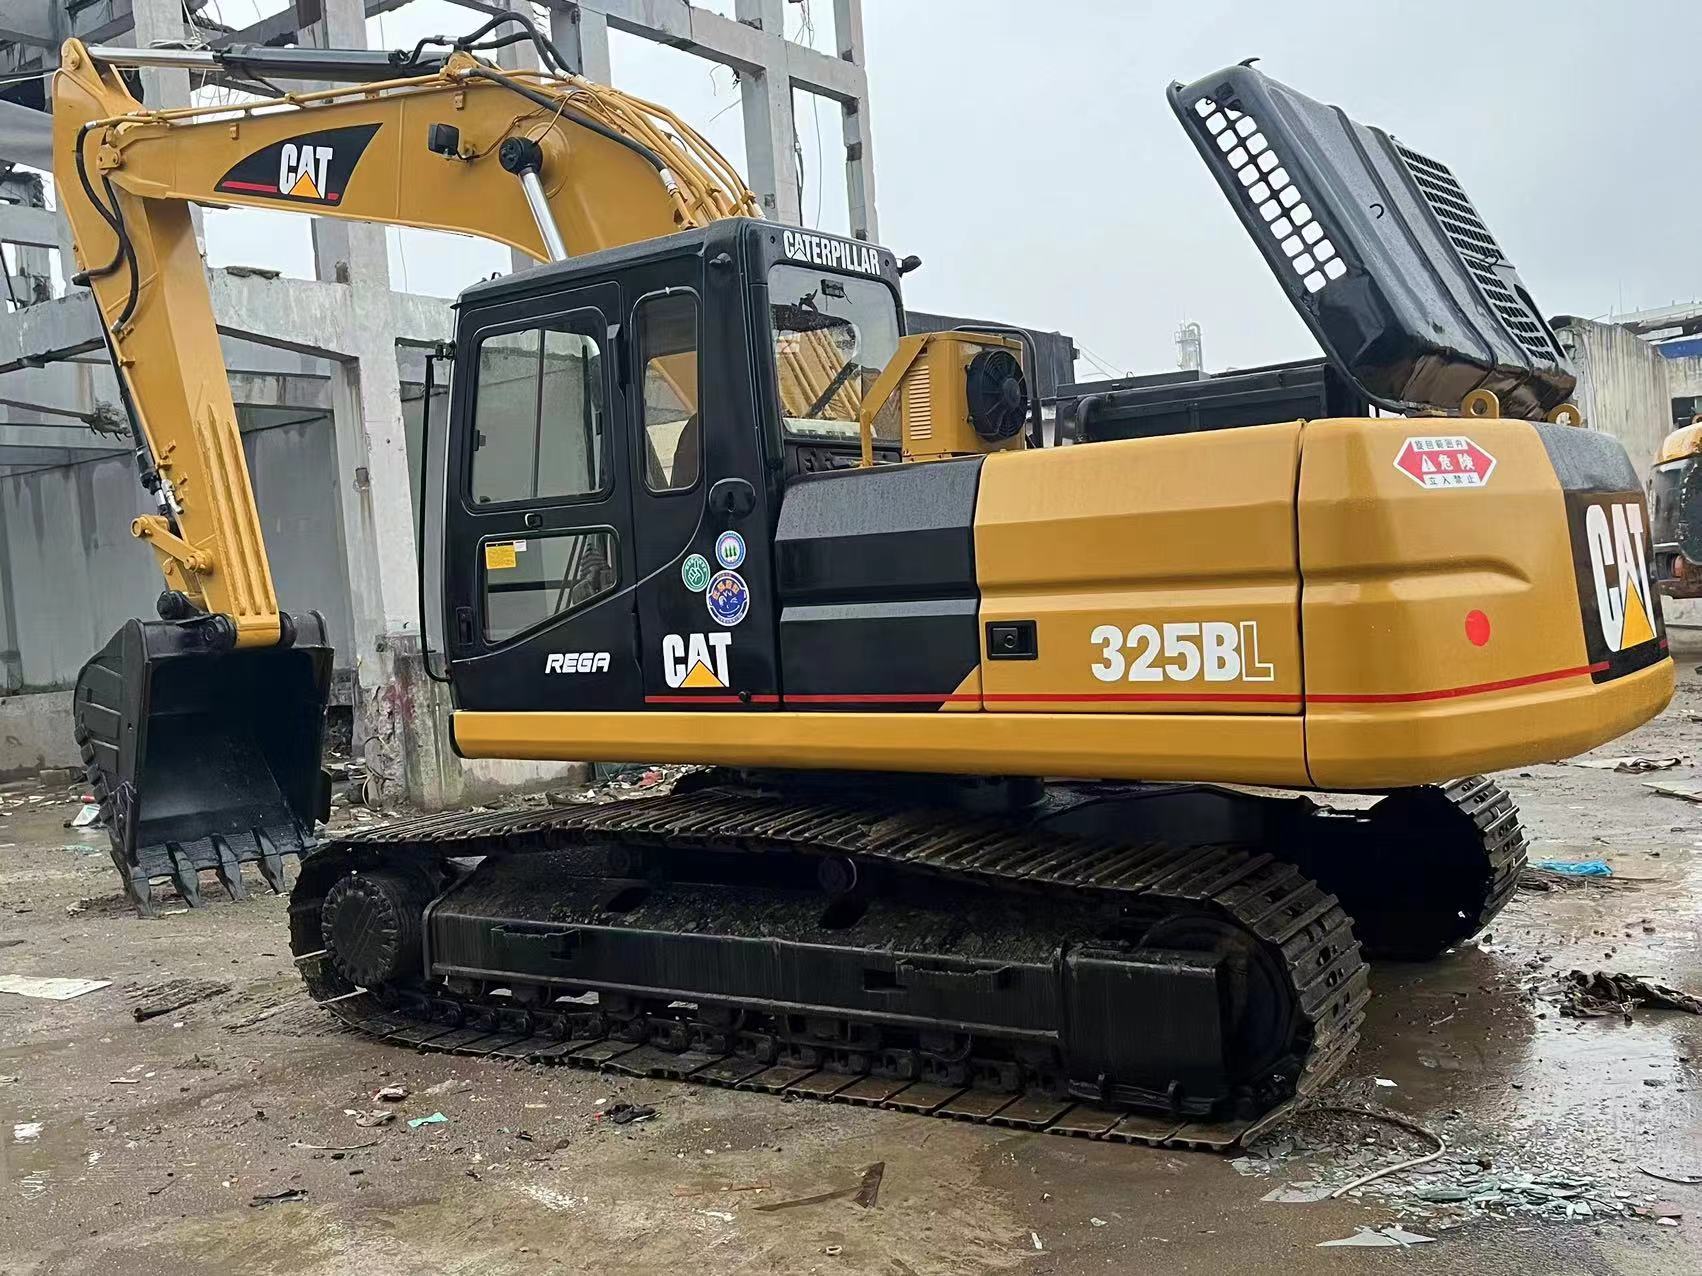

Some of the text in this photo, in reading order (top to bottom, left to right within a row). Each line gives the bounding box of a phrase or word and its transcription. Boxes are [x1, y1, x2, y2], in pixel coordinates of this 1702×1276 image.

[279, 143, 333, 199] CAT
[783, 230, 881, 275] CATERPILLAR
[1585, 503, 1657, 652] CAT
[544, 652, 611, 674] REGA
[662, 632, 732, 688] CAT
[1090, 621, 1274, 682] 325BL
